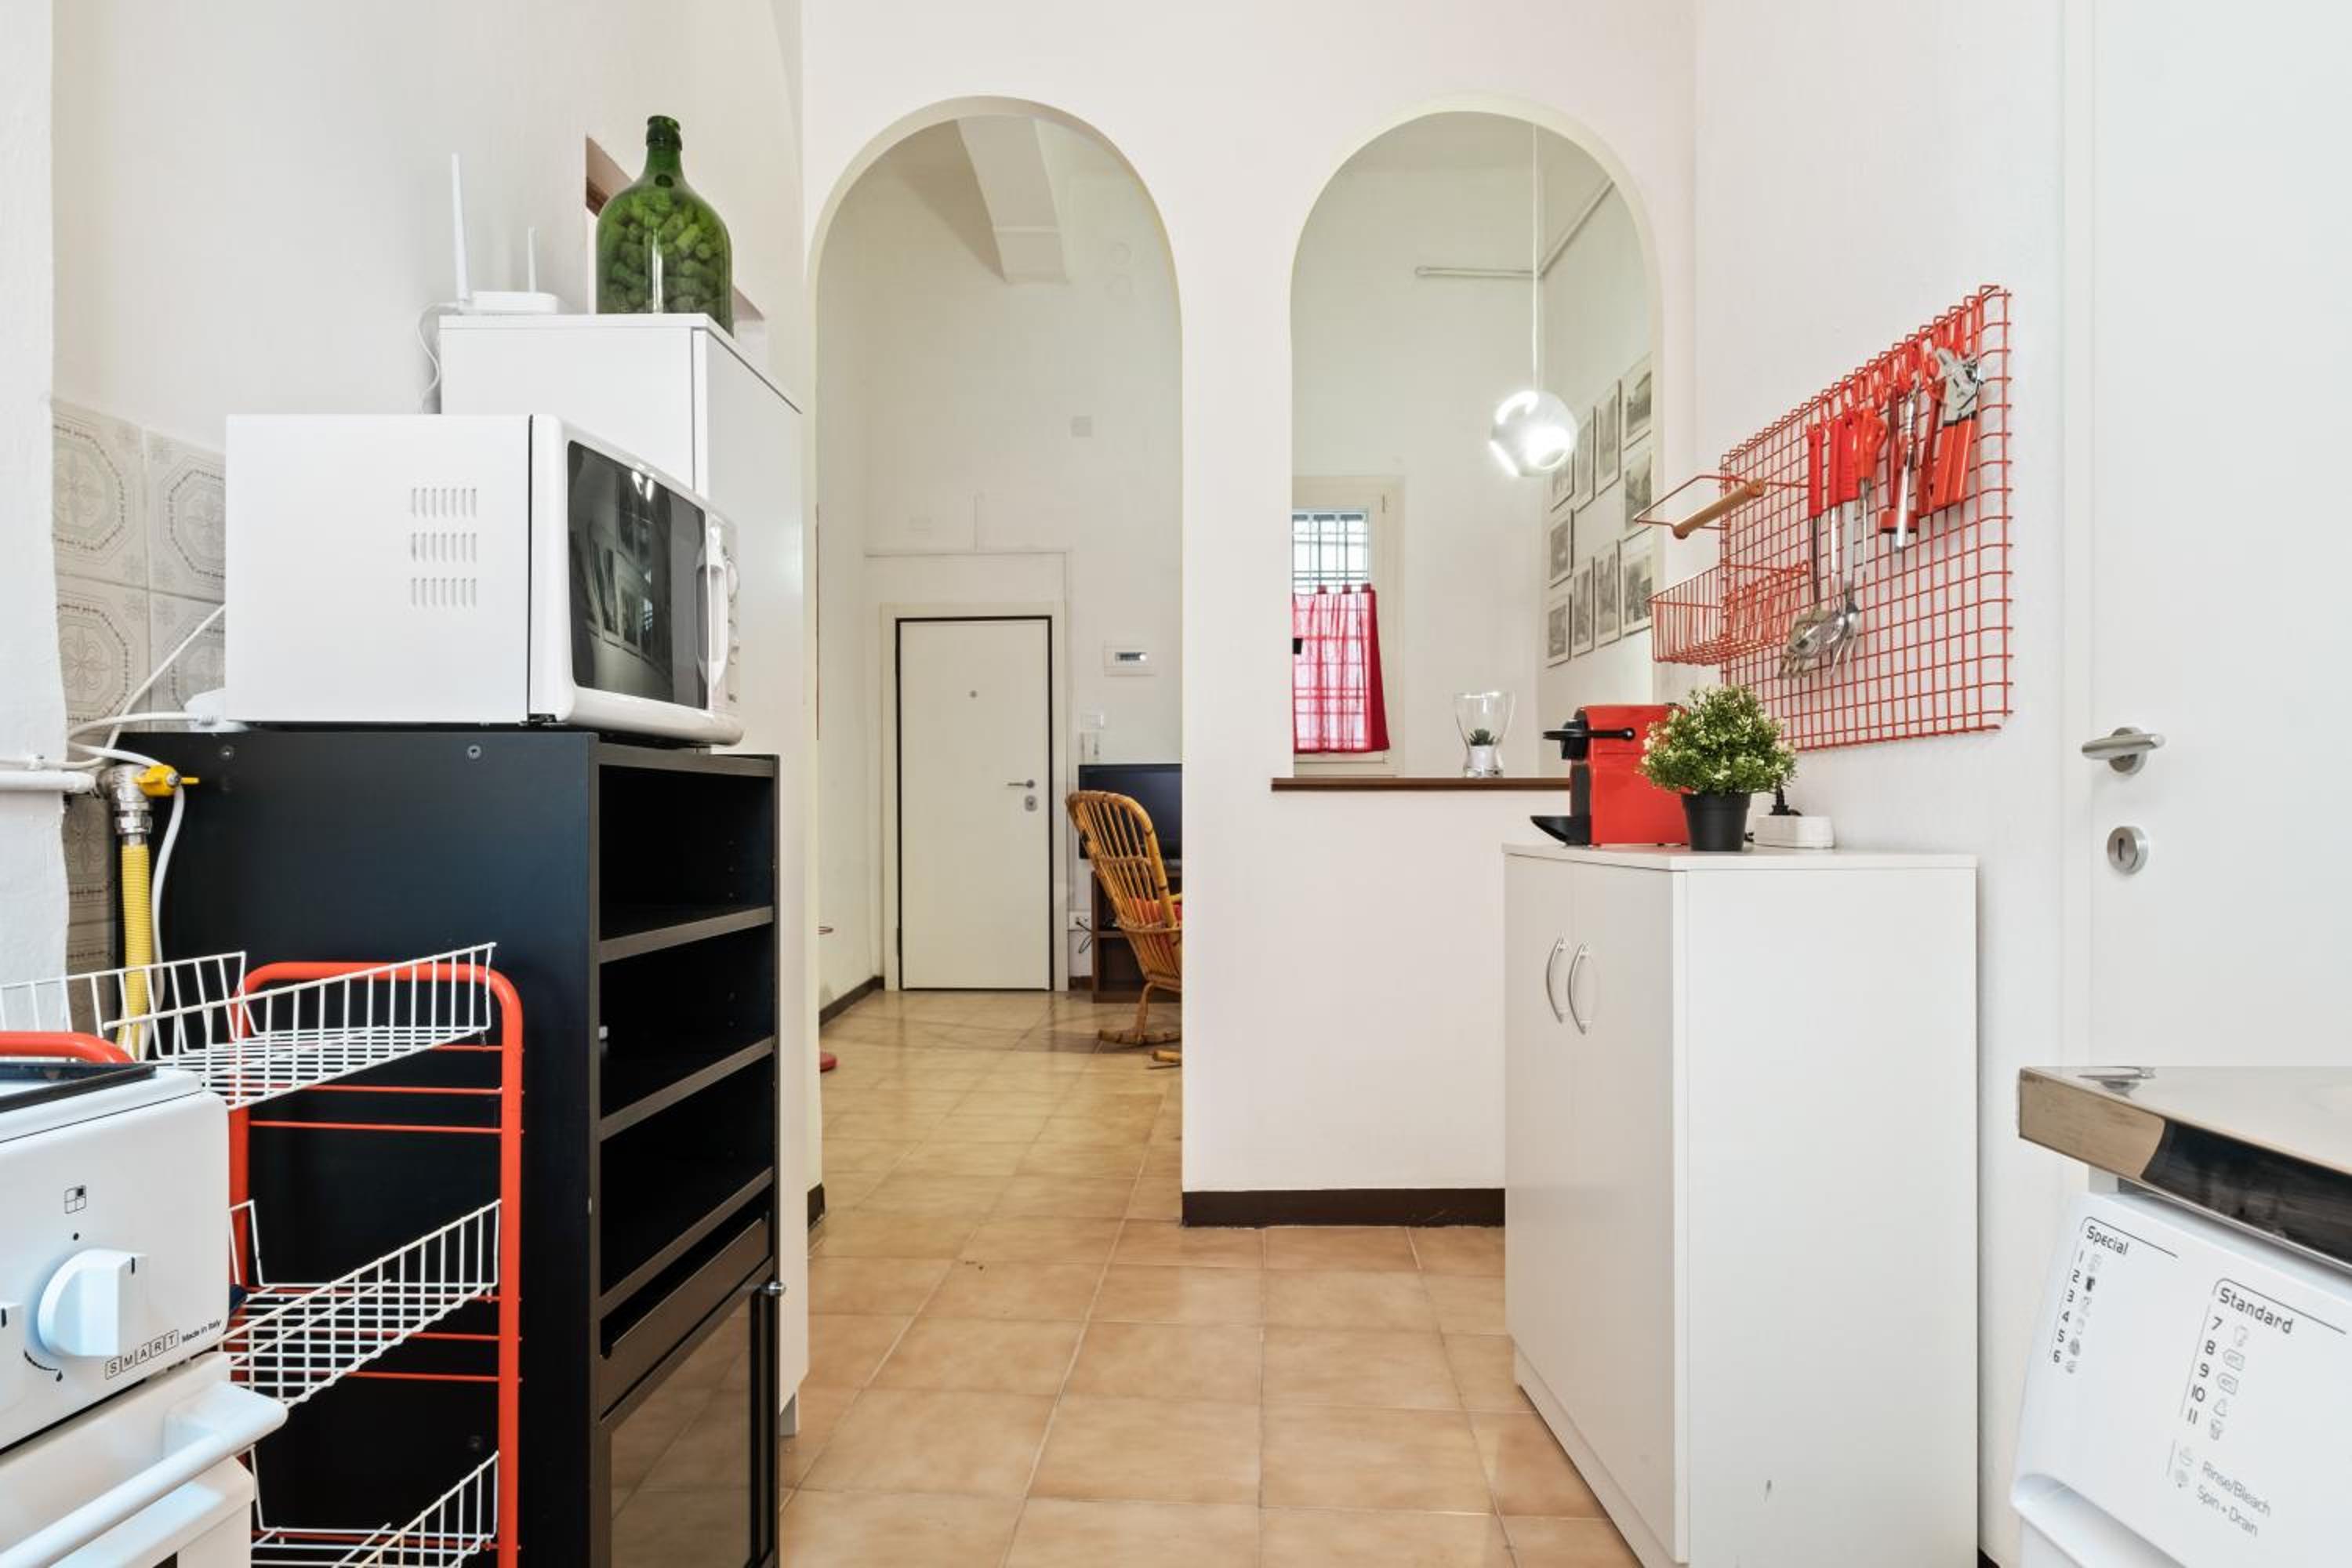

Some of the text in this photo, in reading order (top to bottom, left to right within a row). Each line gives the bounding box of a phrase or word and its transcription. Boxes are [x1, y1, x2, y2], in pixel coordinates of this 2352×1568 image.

[2086, 1225, 2129, 1255] Special
[2072, 1269, 2081, 1283] 2
[2067, 1289, 2075, 1303] 3
[2062, 1311, 2071, 1323] 4
[2219, 1287, 2294, 1334] Standard
[2211, 1316, 2223, 1330] 7
[2056, 1330, 2066, 1343] 5
[108, 1333, 176, 1374] SMART
[2053, 1349, 2061, 1363] 6
[2205, 1339, 2216, 1356] 8
[2198, 1363, 2209, 1378] 9
[2191, 1385, 2205, 1403] 10
[2187, 1408, 2198, 1425] 11
[2202, 1461, 2271, 1518] Rinse/Bleach
[2197, 1484, 2220, 1511] Spin
[2229, 1506, 2258, 1537] Drain
